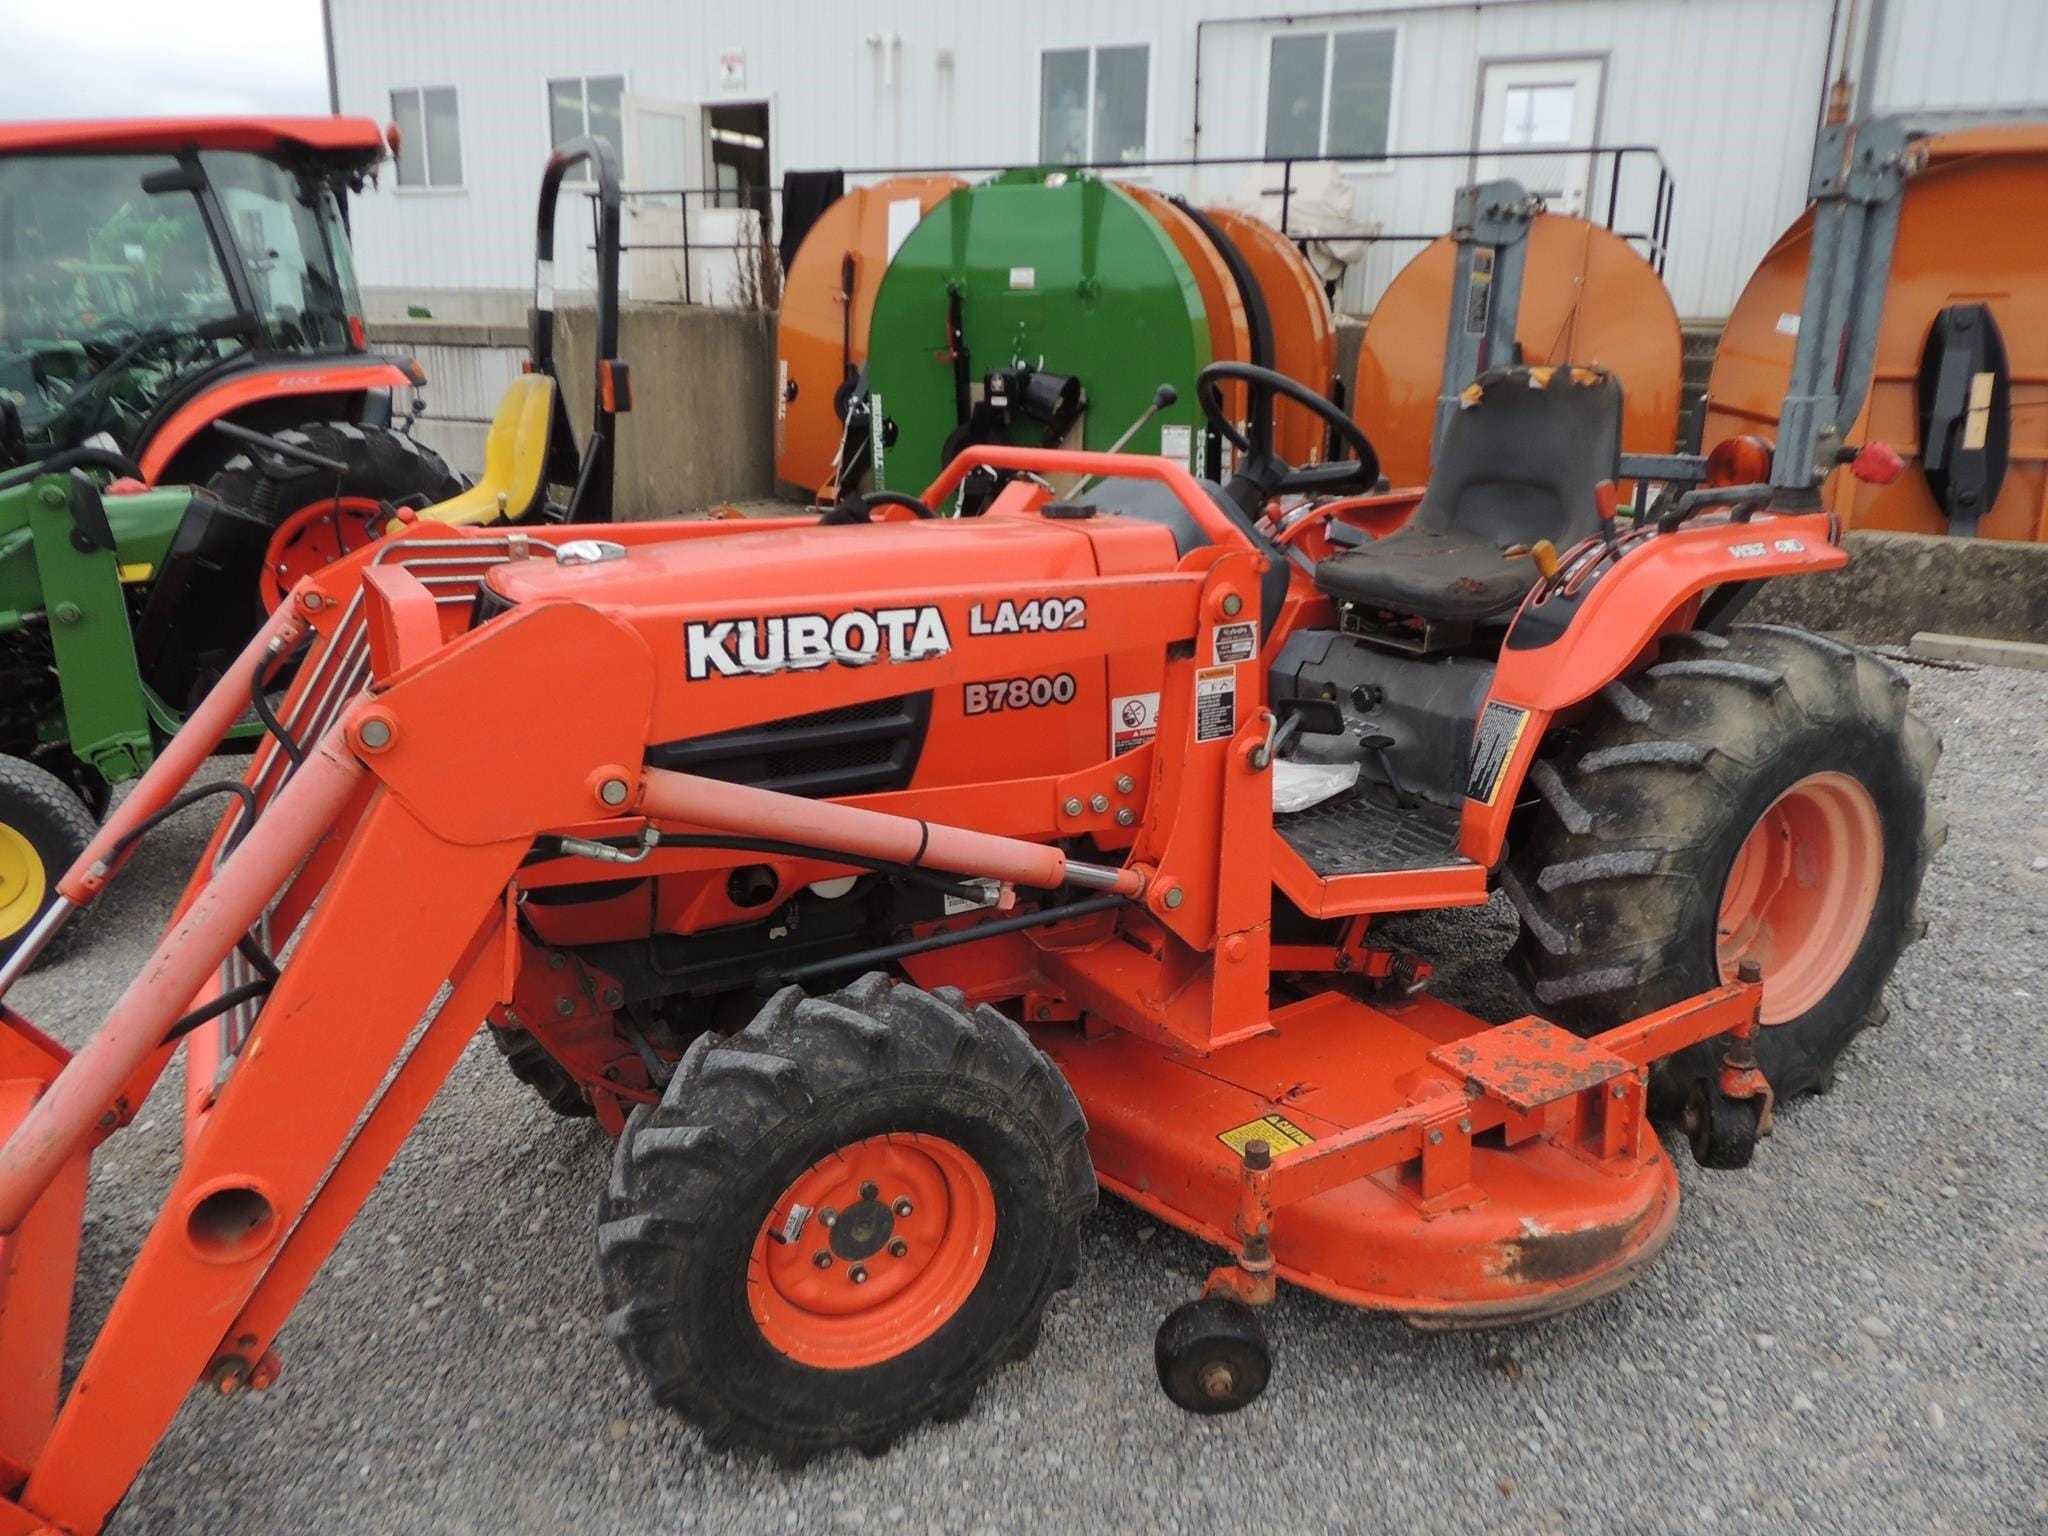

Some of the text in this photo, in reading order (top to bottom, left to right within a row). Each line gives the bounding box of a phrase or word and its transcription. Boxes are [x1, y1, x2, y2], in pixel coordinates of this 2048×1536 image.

[969, 597, 1087, 636] LA402
[685, 605, 951, 680] KUBOTA
[964, 673, 1077, 716] B7800
